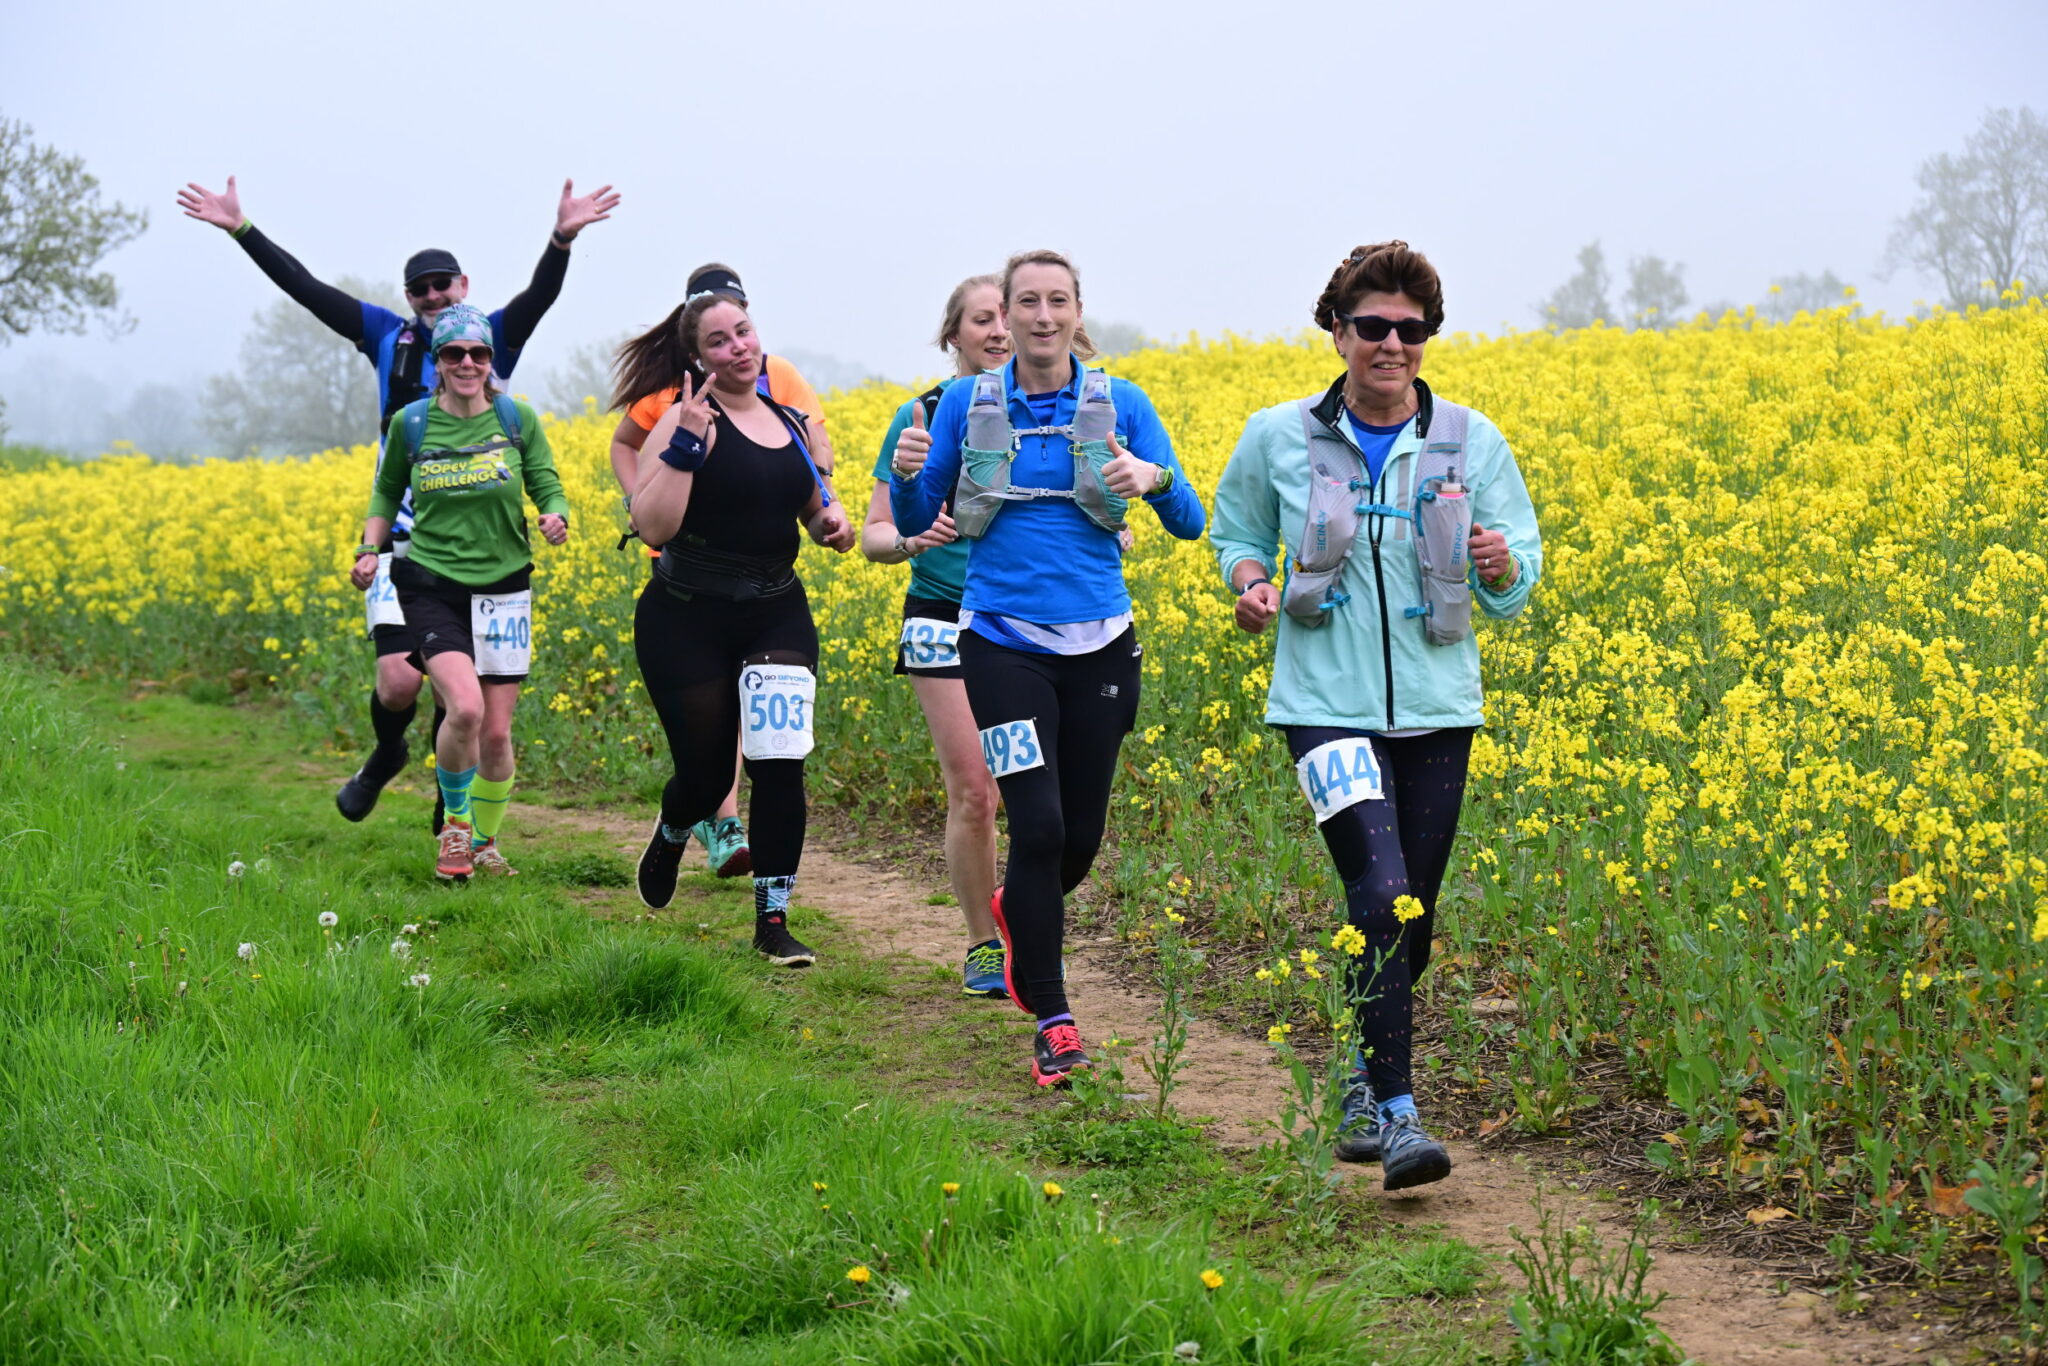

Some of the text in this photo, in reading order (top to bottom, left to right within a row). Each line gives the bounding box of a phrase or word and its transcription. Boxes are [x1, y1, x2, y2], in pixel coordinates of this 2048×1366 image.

[420, 462, 467, 477] DOPEY
[420, 469, 499, 493] CHALLENGE
[485, 616, 528, 650] 440
[902, 625, 957, 663] 435
[750, 692, 805, 732] 503
[984, 721, 1038, 775] 493
[1307, 745, 1380, 808] 444
